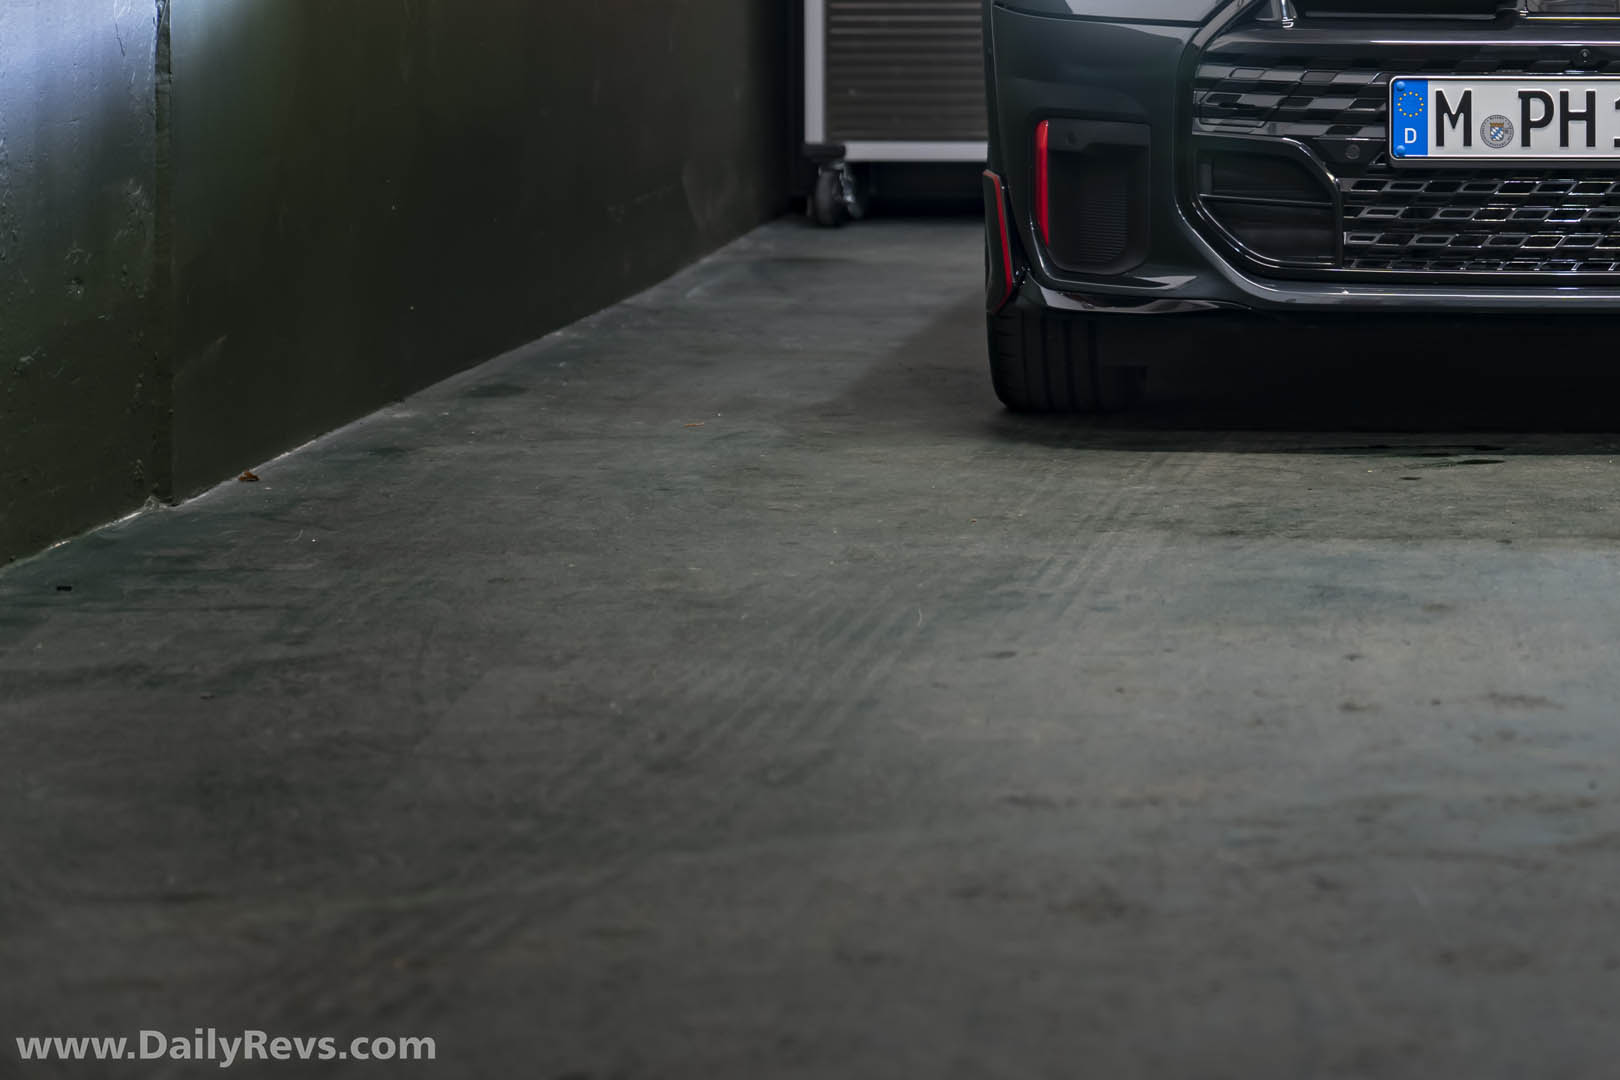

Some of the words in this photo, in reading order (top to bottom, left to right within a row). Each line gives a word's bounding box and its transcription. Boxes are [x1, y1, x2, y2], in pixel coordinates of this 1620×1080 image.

[1404, 127, 1418, 144] D
[1434, 89, 1473, 148] M
[1517, 89, 1597, 148] PH
